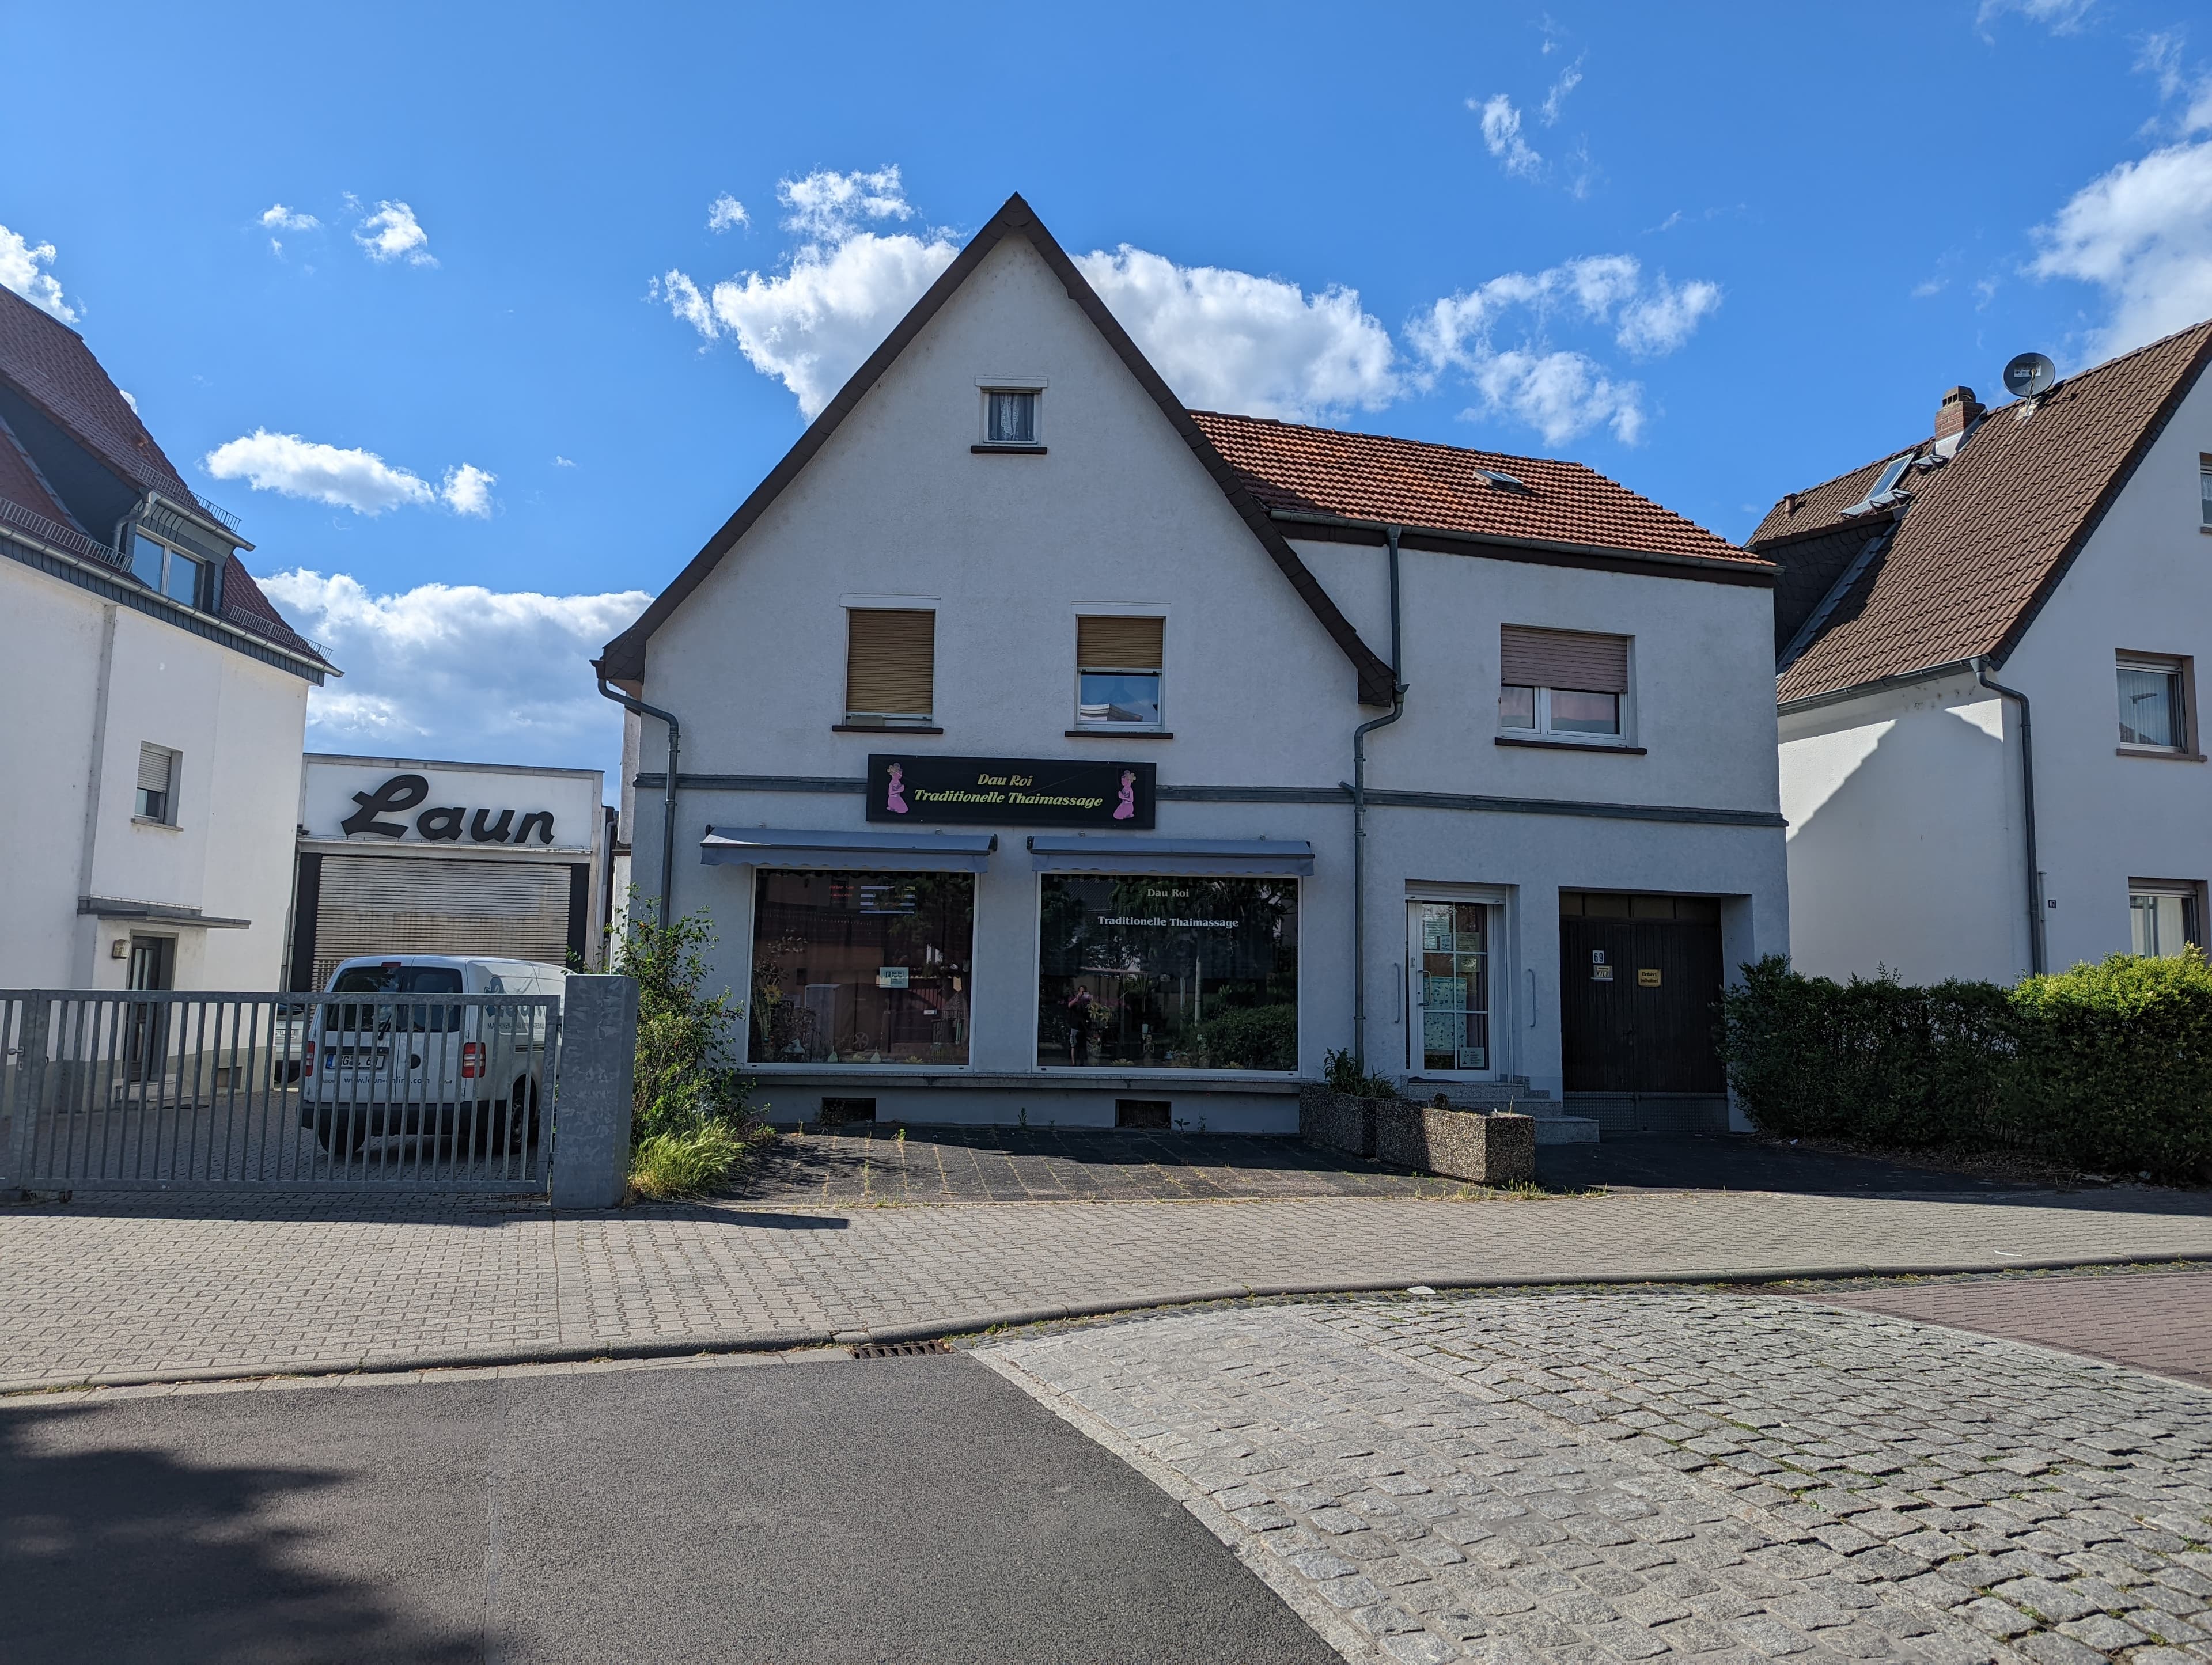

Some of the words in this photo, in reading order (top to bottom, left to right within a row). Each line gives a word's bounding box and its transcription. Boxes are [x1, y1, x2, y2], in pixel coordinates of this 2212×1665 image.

[978, 774, 1007, 786] Dau
[1009, 775, 1033, 786] Roi
[914, 790, 1005, 803] Traditionelle
[1008, 792, 1103, 809] Thaimassage
[340, 774, 555, 844] Laun
[1147, 889, 1168, 897] Dau
[1172, 889, 1189, 897] Roi
[1097, 916, 1166, 926] Traditionelle
[1169, 918, 1238, 929] Thaimassage
[1594, 953, 1603, 962] 69
